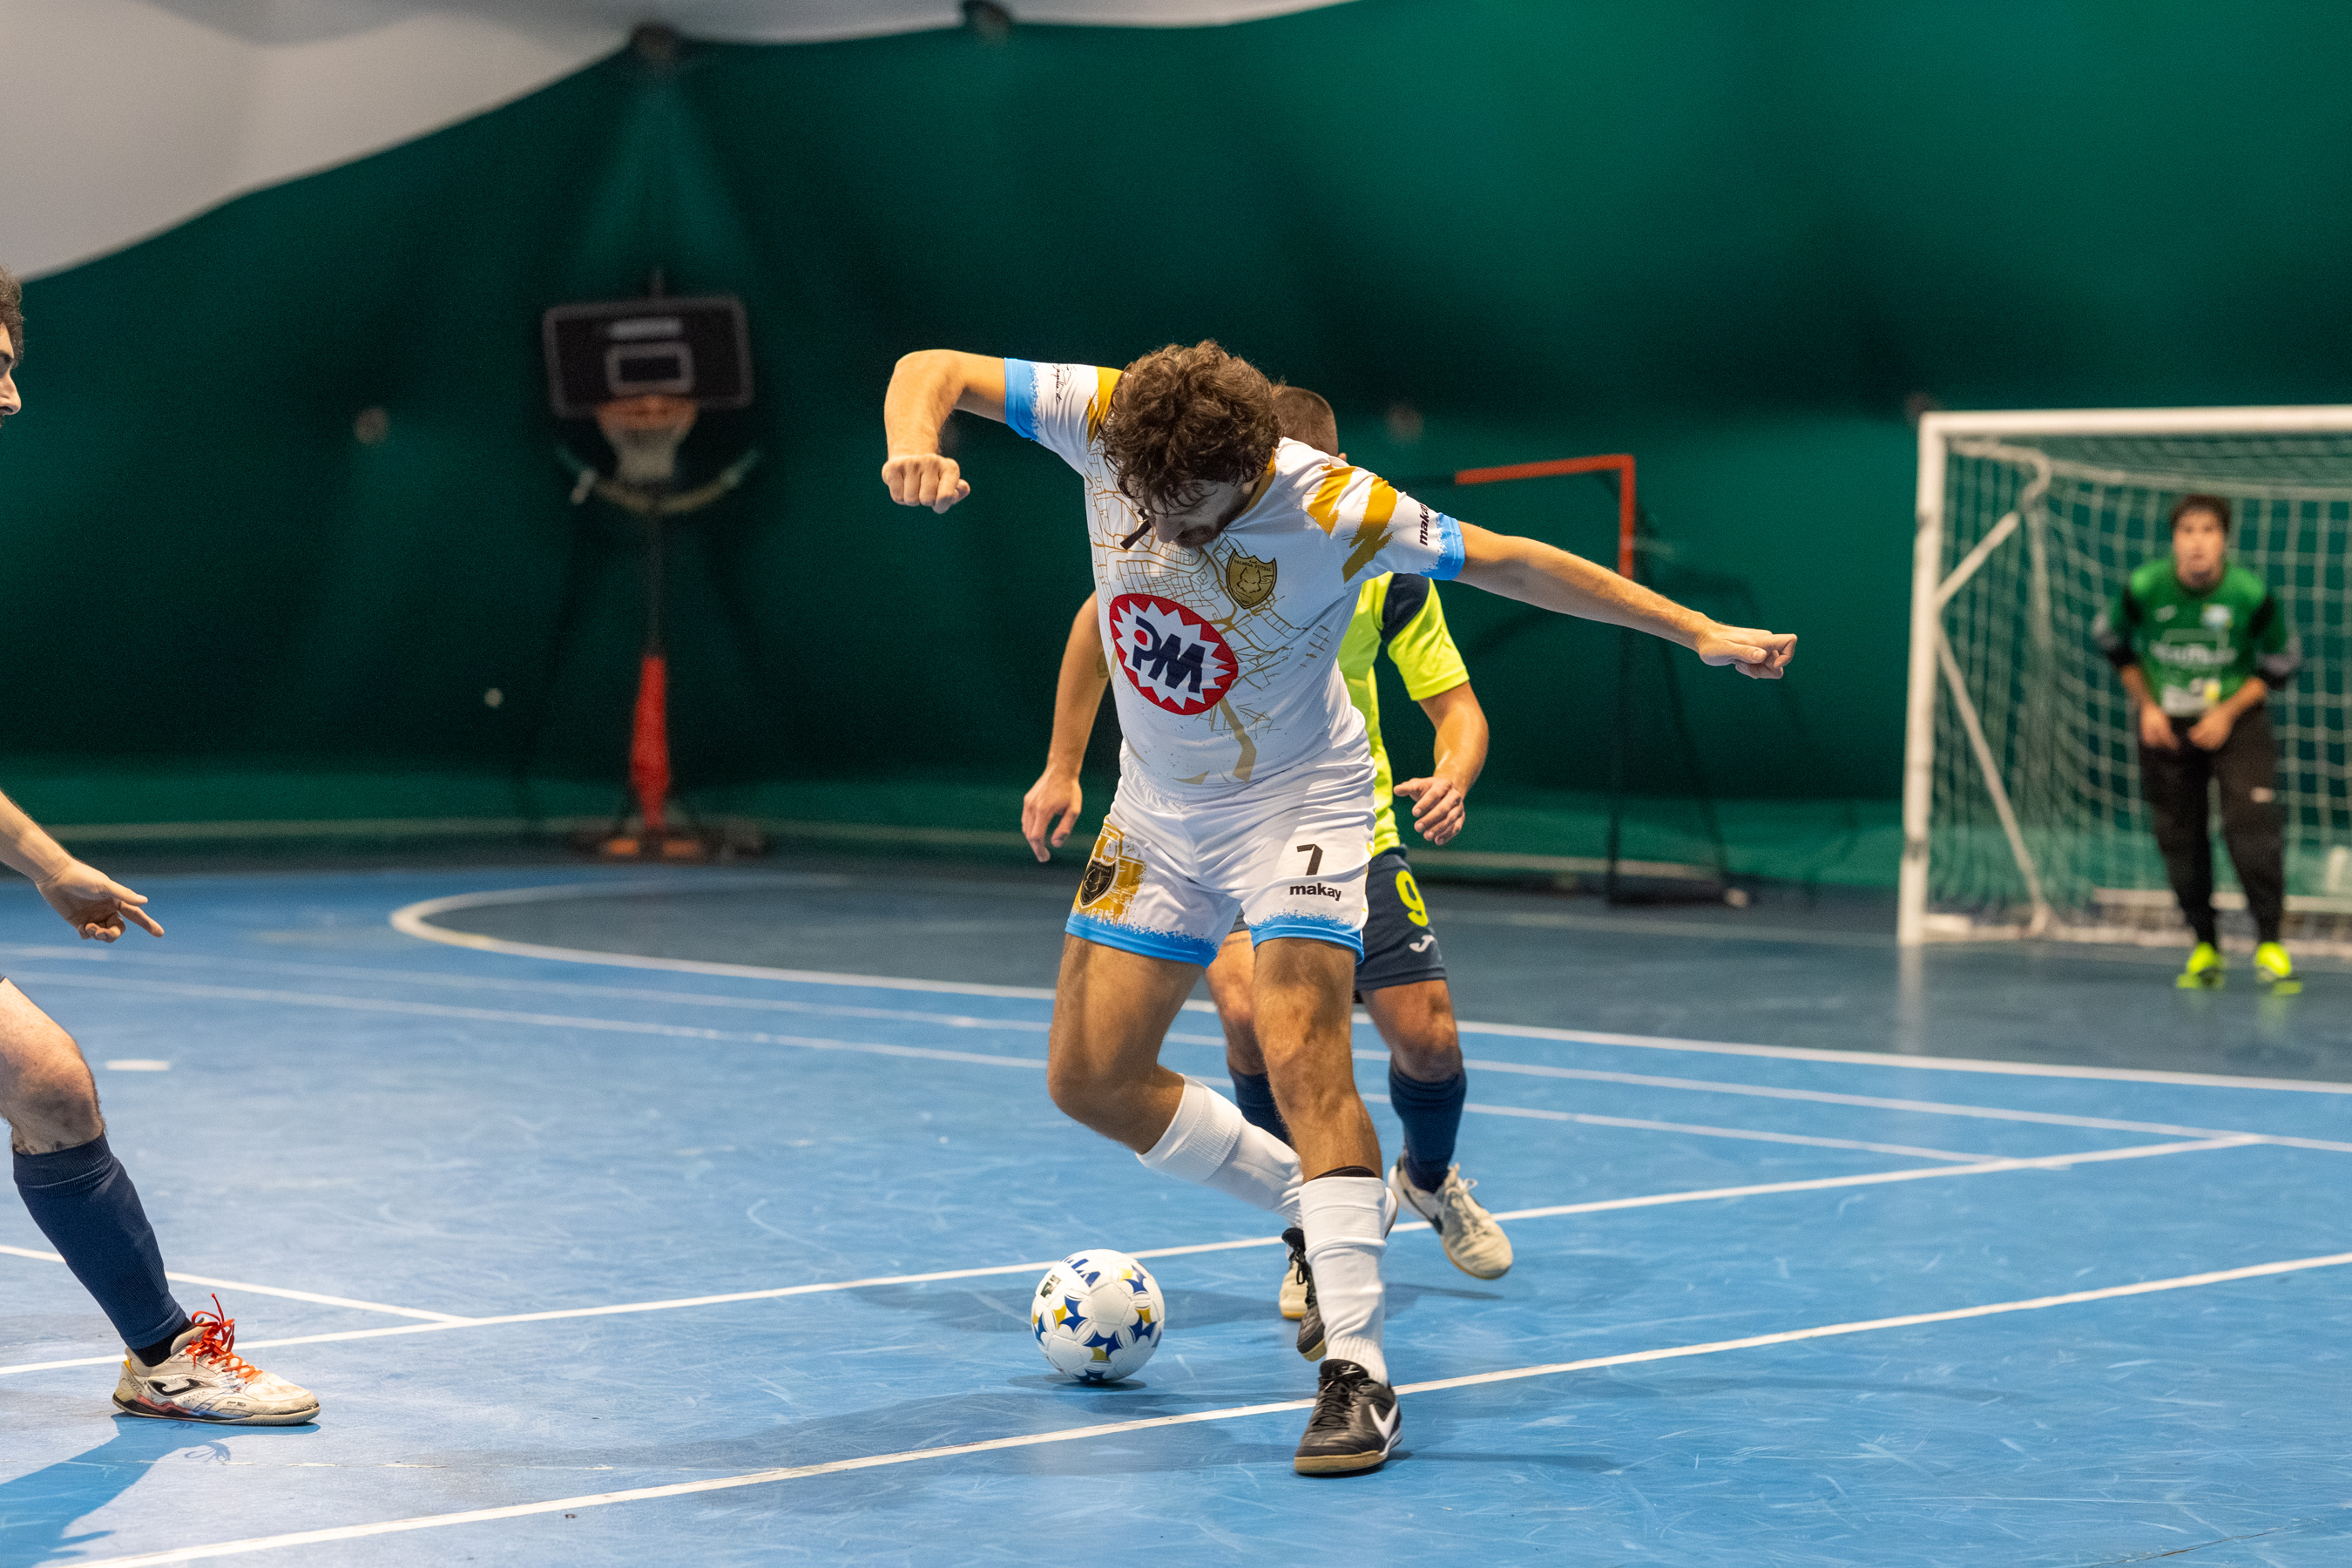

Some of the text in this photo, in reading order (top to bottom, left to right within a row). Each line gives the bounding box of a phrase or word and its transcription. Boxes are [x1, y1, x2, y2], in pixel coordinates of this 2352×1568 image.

[1296, 843, 1323, 876] 7
[1289, 882, 1342, 902] makay
[1396, 870, 1429, 927] 9
